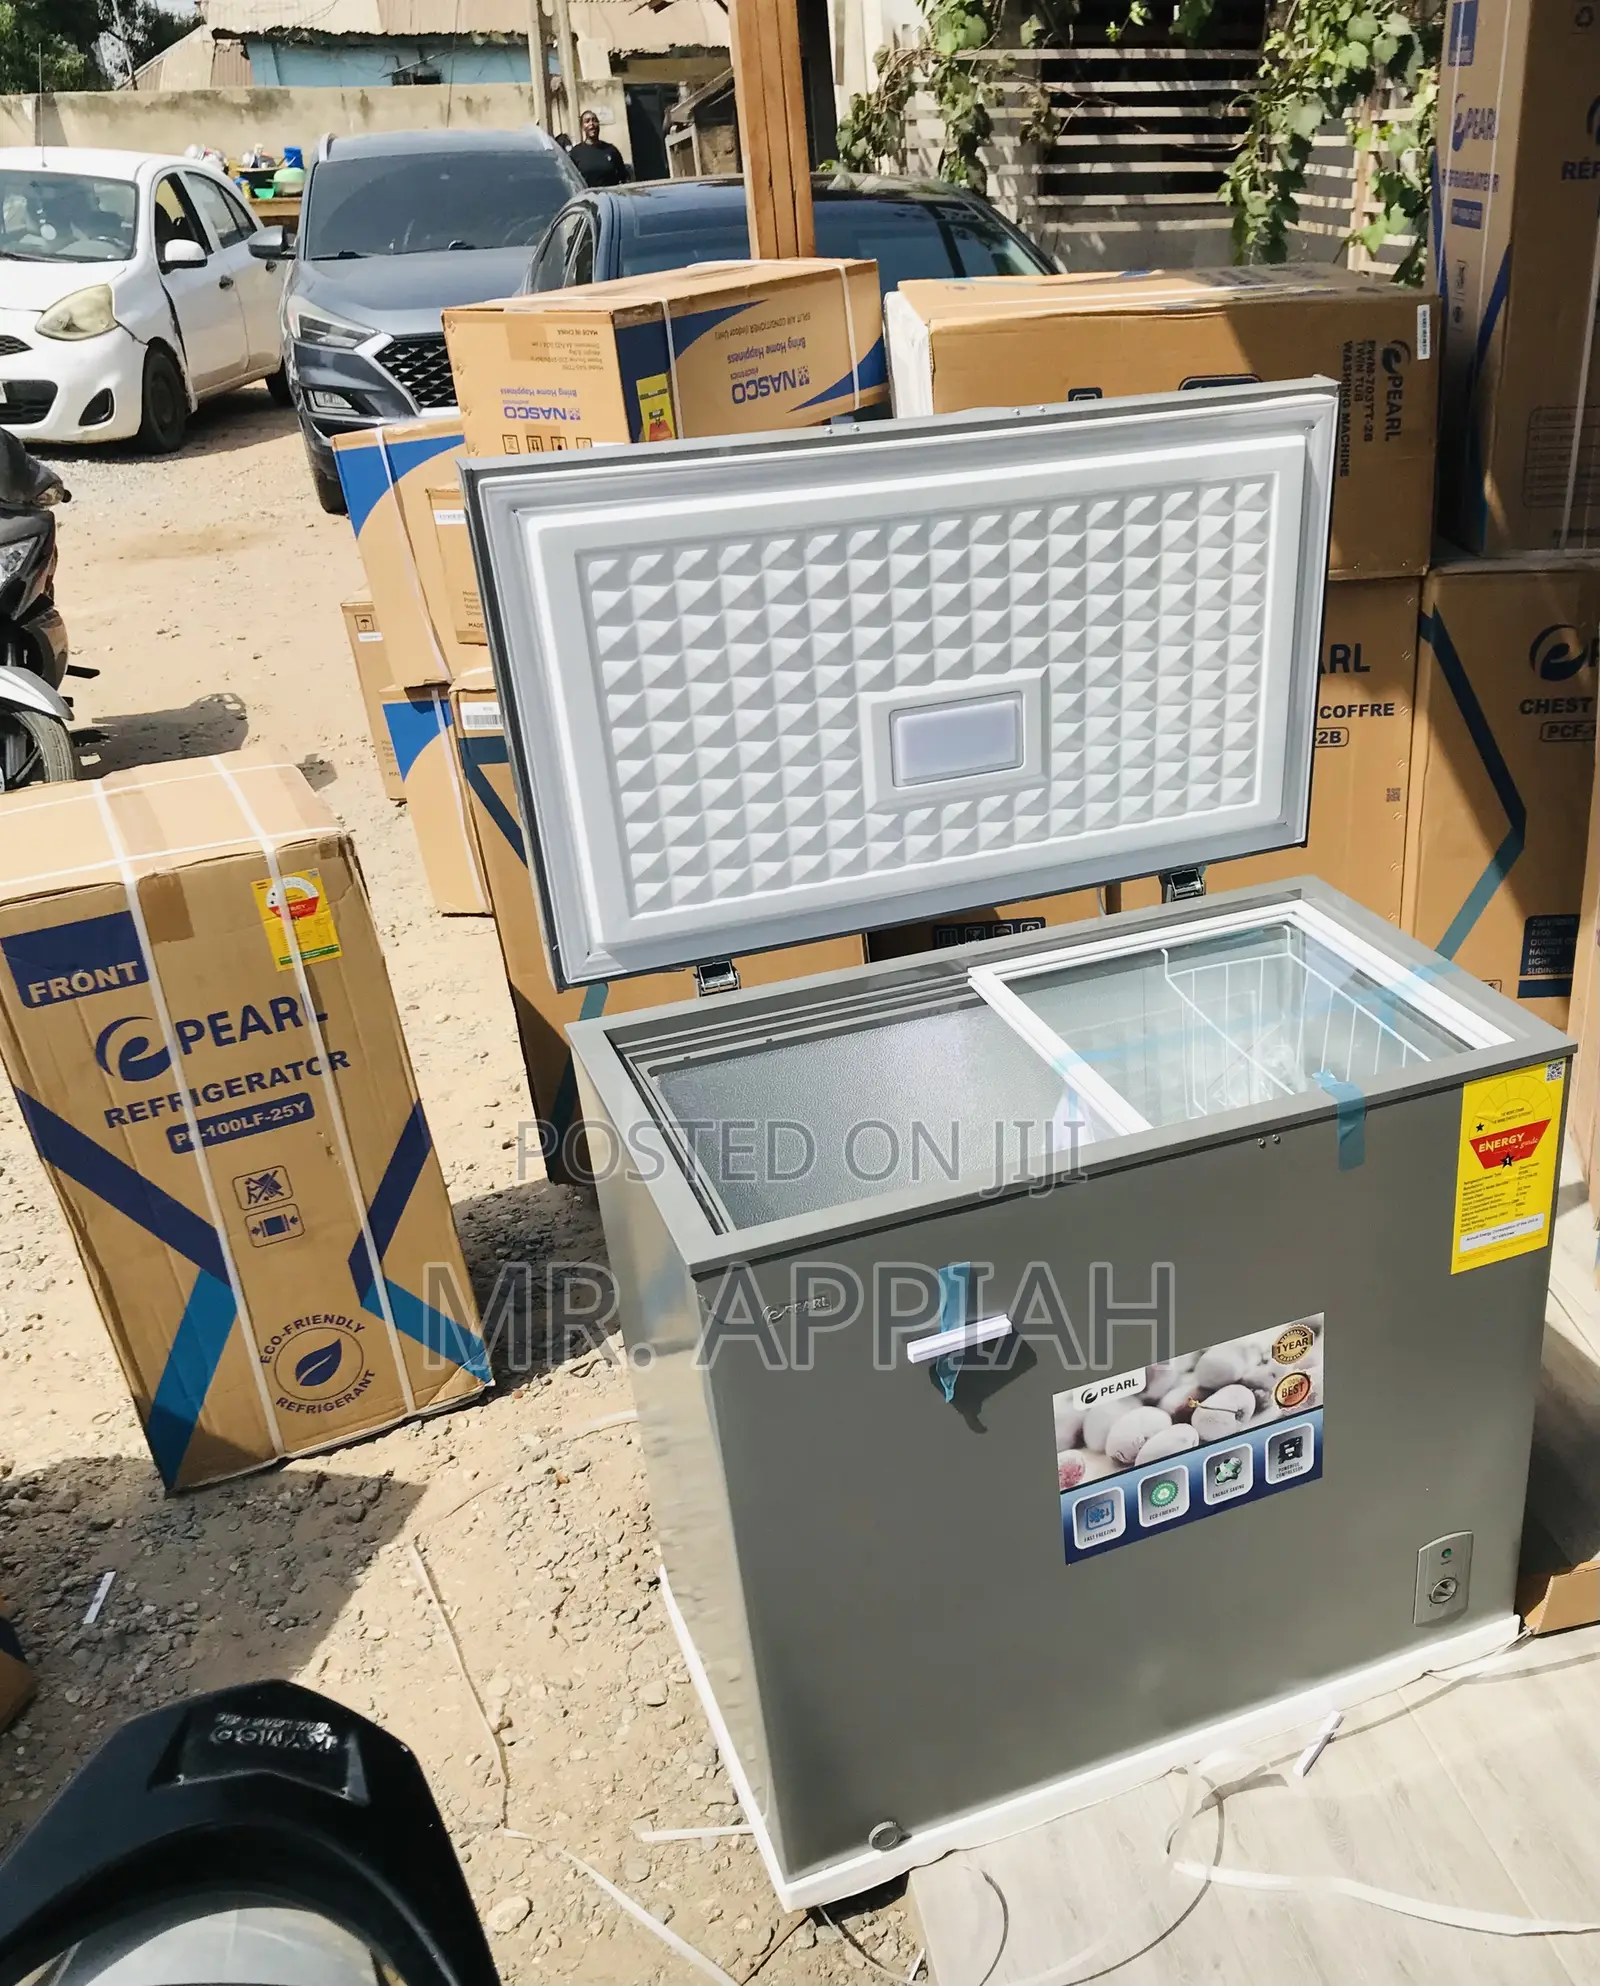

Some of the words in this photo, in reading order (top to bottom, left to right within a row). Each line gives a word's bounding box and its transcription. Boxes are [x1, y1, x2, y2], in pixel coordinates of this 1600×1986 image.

[765, 341, 787, 354] Home
[787, 336, 806, 350] Bring
[727, 345, 765, 364] Happiness
[1355, 341, 1365, 373] TWIN
[1341, 340, 1353, 409] WASHING
[500, 386, 535, 397] Happiness
[536, 388, 557, 397] Home
[558, 387, 578, 397] Bring
[731, 368, 797, 404] NASCO
[1354, 376, 1364, 402] TUB
[503, 406, 567, 420] NASCO
[1385, 375, 1403, 442] PEARL
[1339, 412, 1351, 477] MACHINE
[1319, 702, 1395, 719] COFFRE
[1519, 697, 1593, 715] CHEST
[27, 961, 139, 1004] FRONT
[104, 1050, 351, 1129] REFRIGERATOR
[173, 1100, 307, 1146] P-100LF-25Y
[1479, 1132, 1526, 1152] ENERGY
[259, 1313, 366, 1364] ECO-FRIENDLY
[1282, 1337, 1309, 1352] YEAR
[276, 1369, 376, 1415] REFRIGERANT
[1100, 1377, 1139, 1398] PEARL
[1281, 1382, 1305, 1399] BEST
